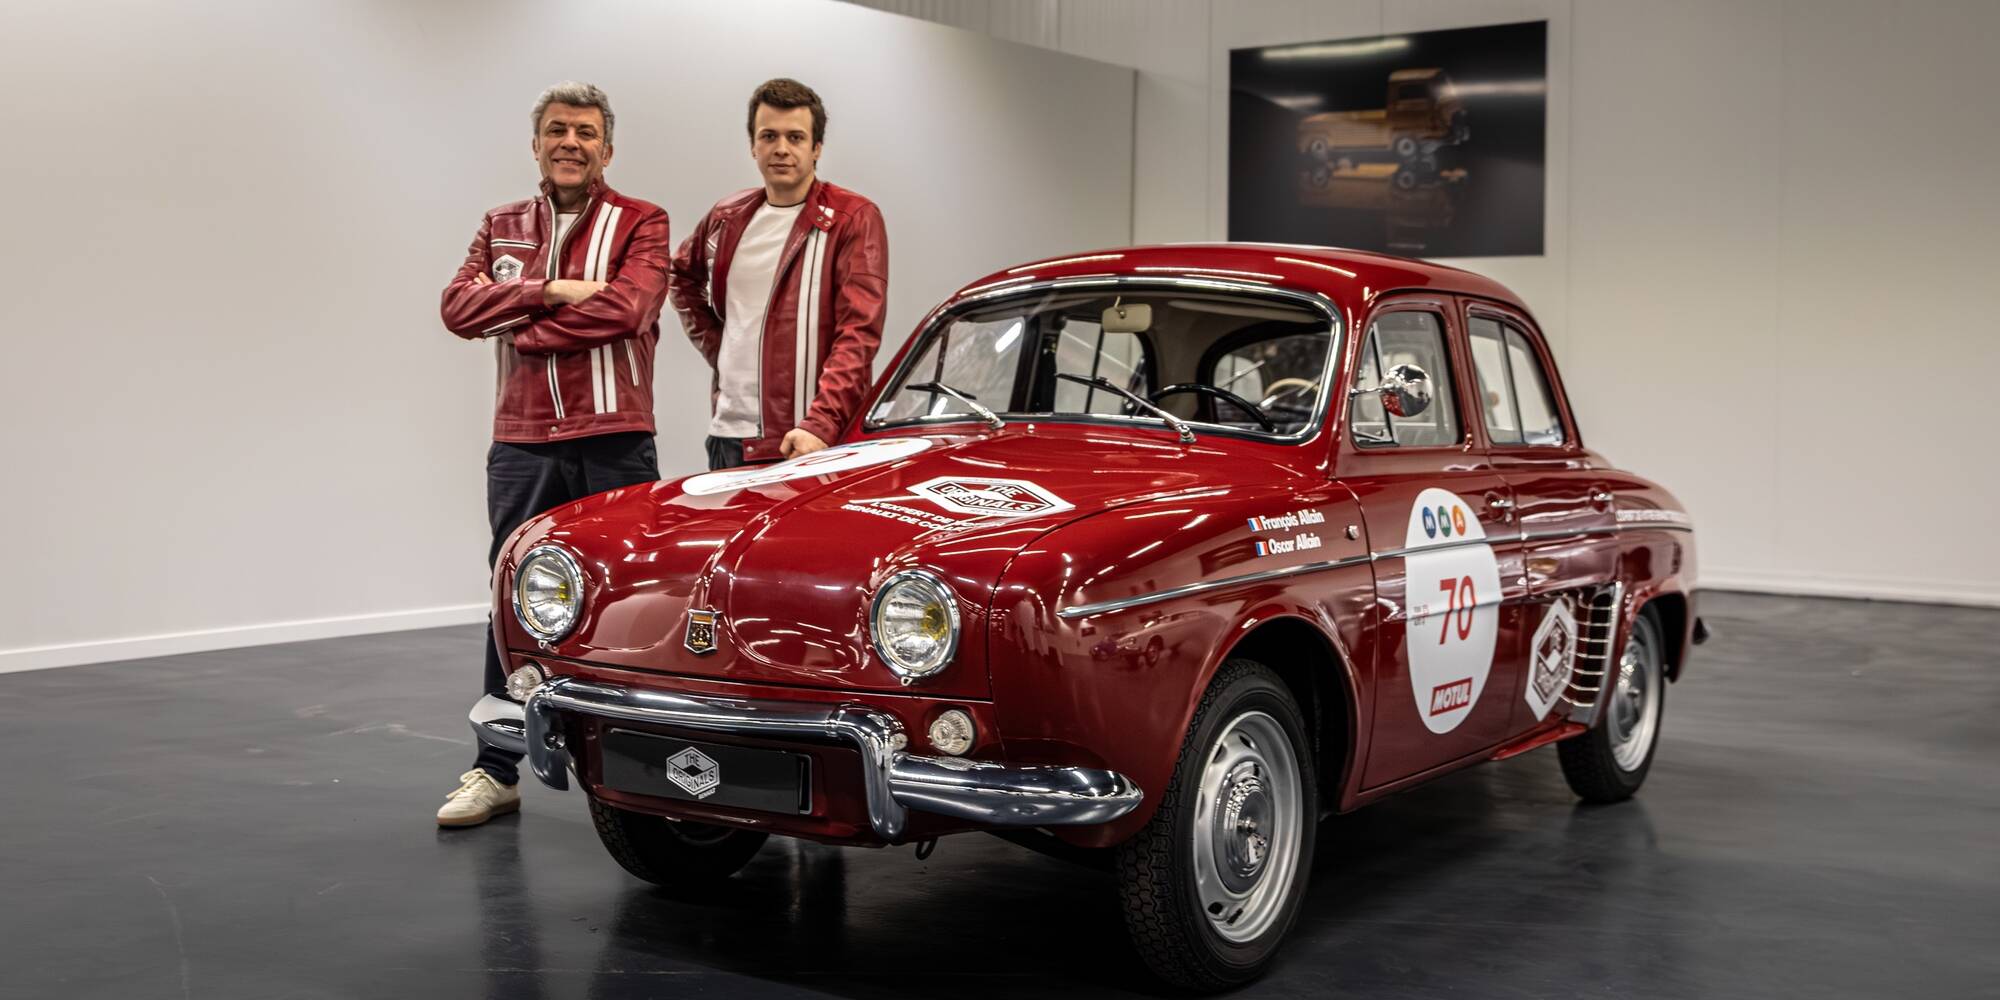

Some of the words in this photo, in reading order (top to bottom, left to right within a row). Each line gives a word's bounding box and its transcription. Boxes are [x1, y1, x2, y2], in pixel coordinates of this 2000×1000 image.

[985, 484, 1023, 499] THE
[1259, 511, 1299, 531] François
[1298, 508, 1325, 525] Allain
[1268, 538, 1295, 555] Oscar
[1296, 532, 1321, 550] Allain
[1439, 575, 1476, 645] 70
[1431, 682, 1470, 712] MOTUL
[685, 752, 701, 767] THE
[672, 767, 715, 790] ORIGINALS
